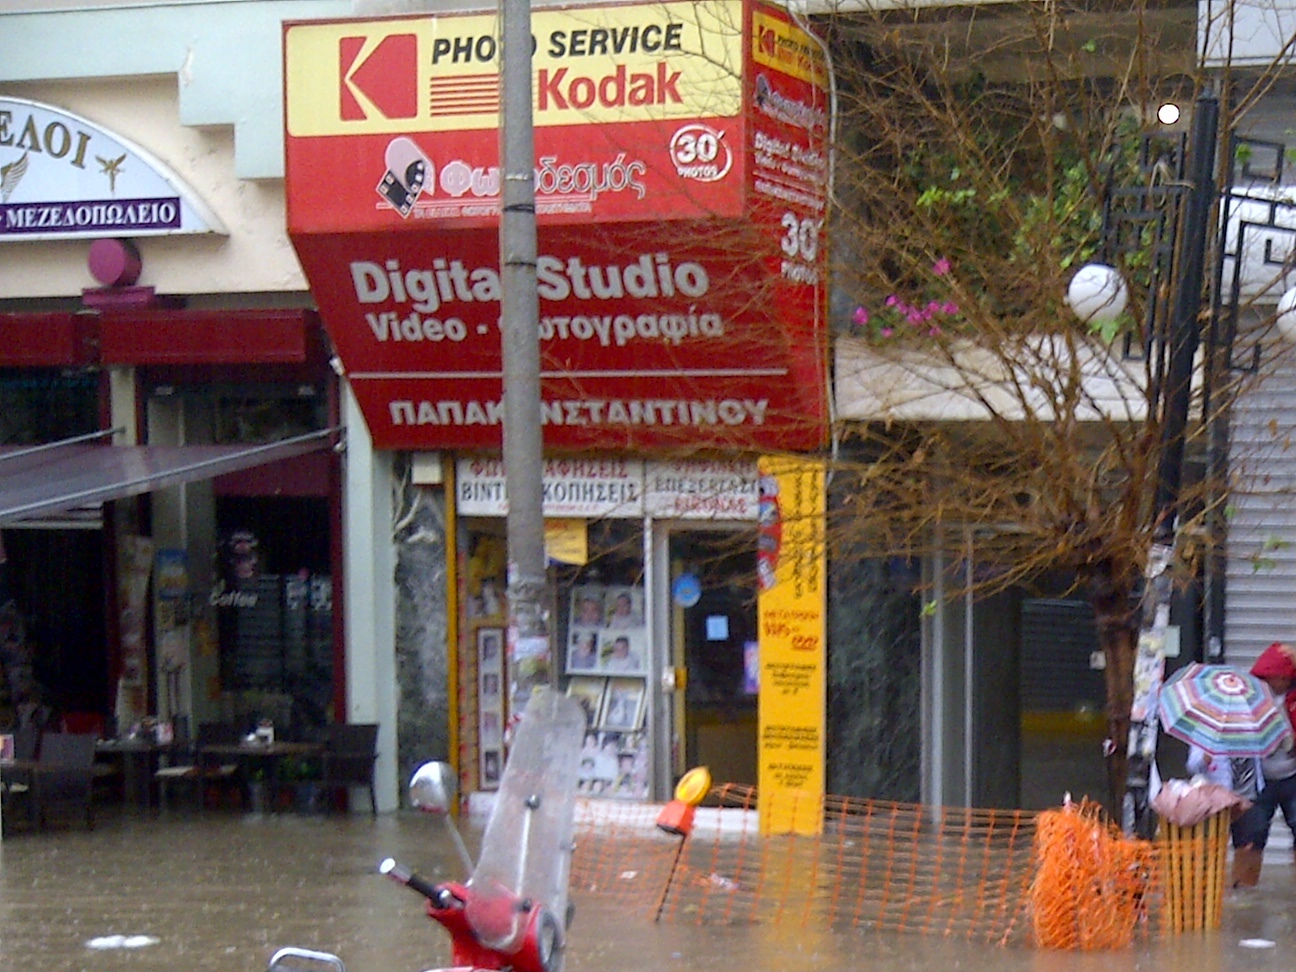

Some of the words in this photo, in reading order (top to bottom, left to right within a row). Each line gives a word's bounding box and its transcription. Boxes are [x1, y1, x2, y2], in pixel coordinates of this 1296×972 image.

[431, 30, 537, 65] PHO
[548, 23, 683, 58] SERVICE
[537, 61, 683, 111] Kodak
[5, 202, 176, 229] ΜΕΖΕΔΟΠΩΛΕΙΟ
[350, 259, 502, 315] Digita
[537, 252, 710, 300] Studio
[366, 311, 466, 342] Video
[388, 398, 770, 427] ΠΑΠΑΚΝΣΤΑΝΤΙΝΟΥ
